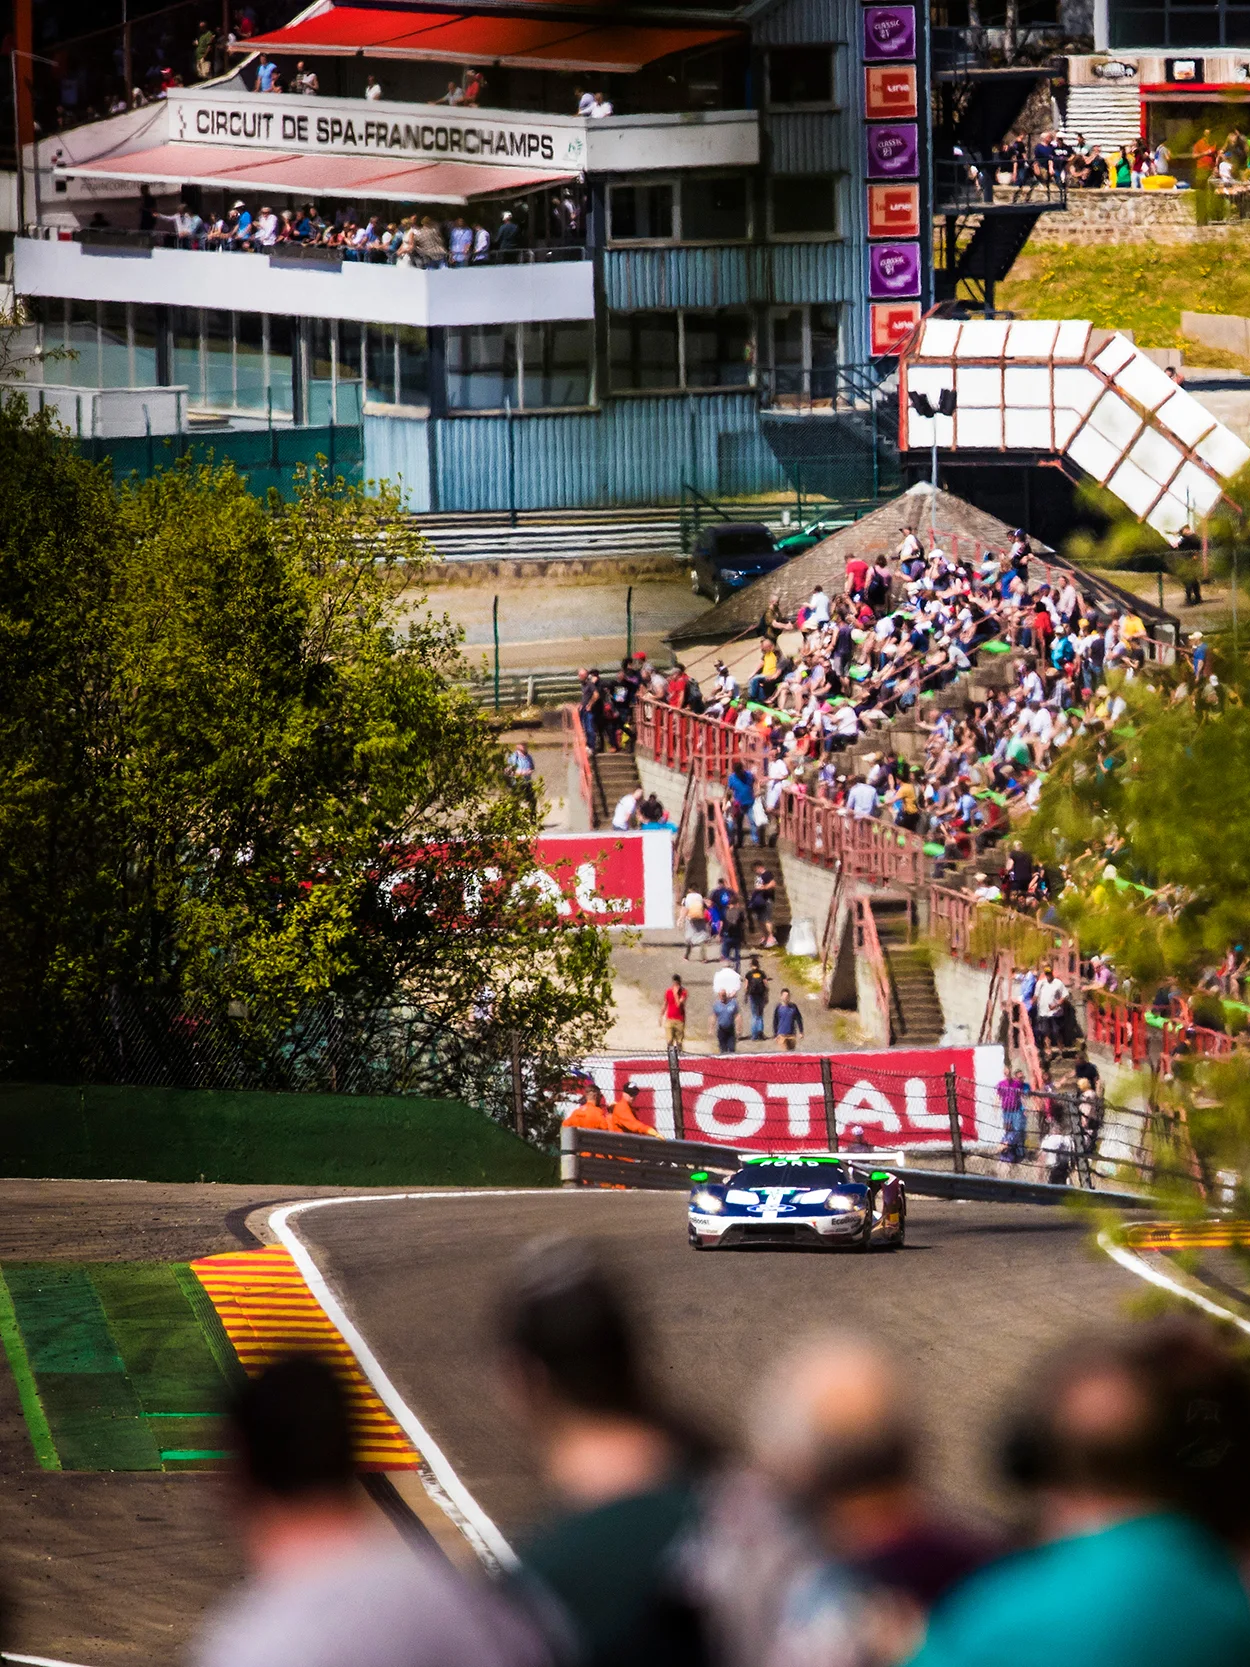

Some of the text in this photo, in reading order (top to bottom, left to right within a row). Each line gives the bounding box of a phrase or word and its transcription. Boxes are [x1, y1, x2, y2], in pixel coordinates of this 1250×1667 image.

[196, 109, 554, 160] CIRCUIT DE SPA-FRANCORCHAMPS
[312, 858, 632, 918] OTAL
[628, 1071, 963, 1140] TOTAL
